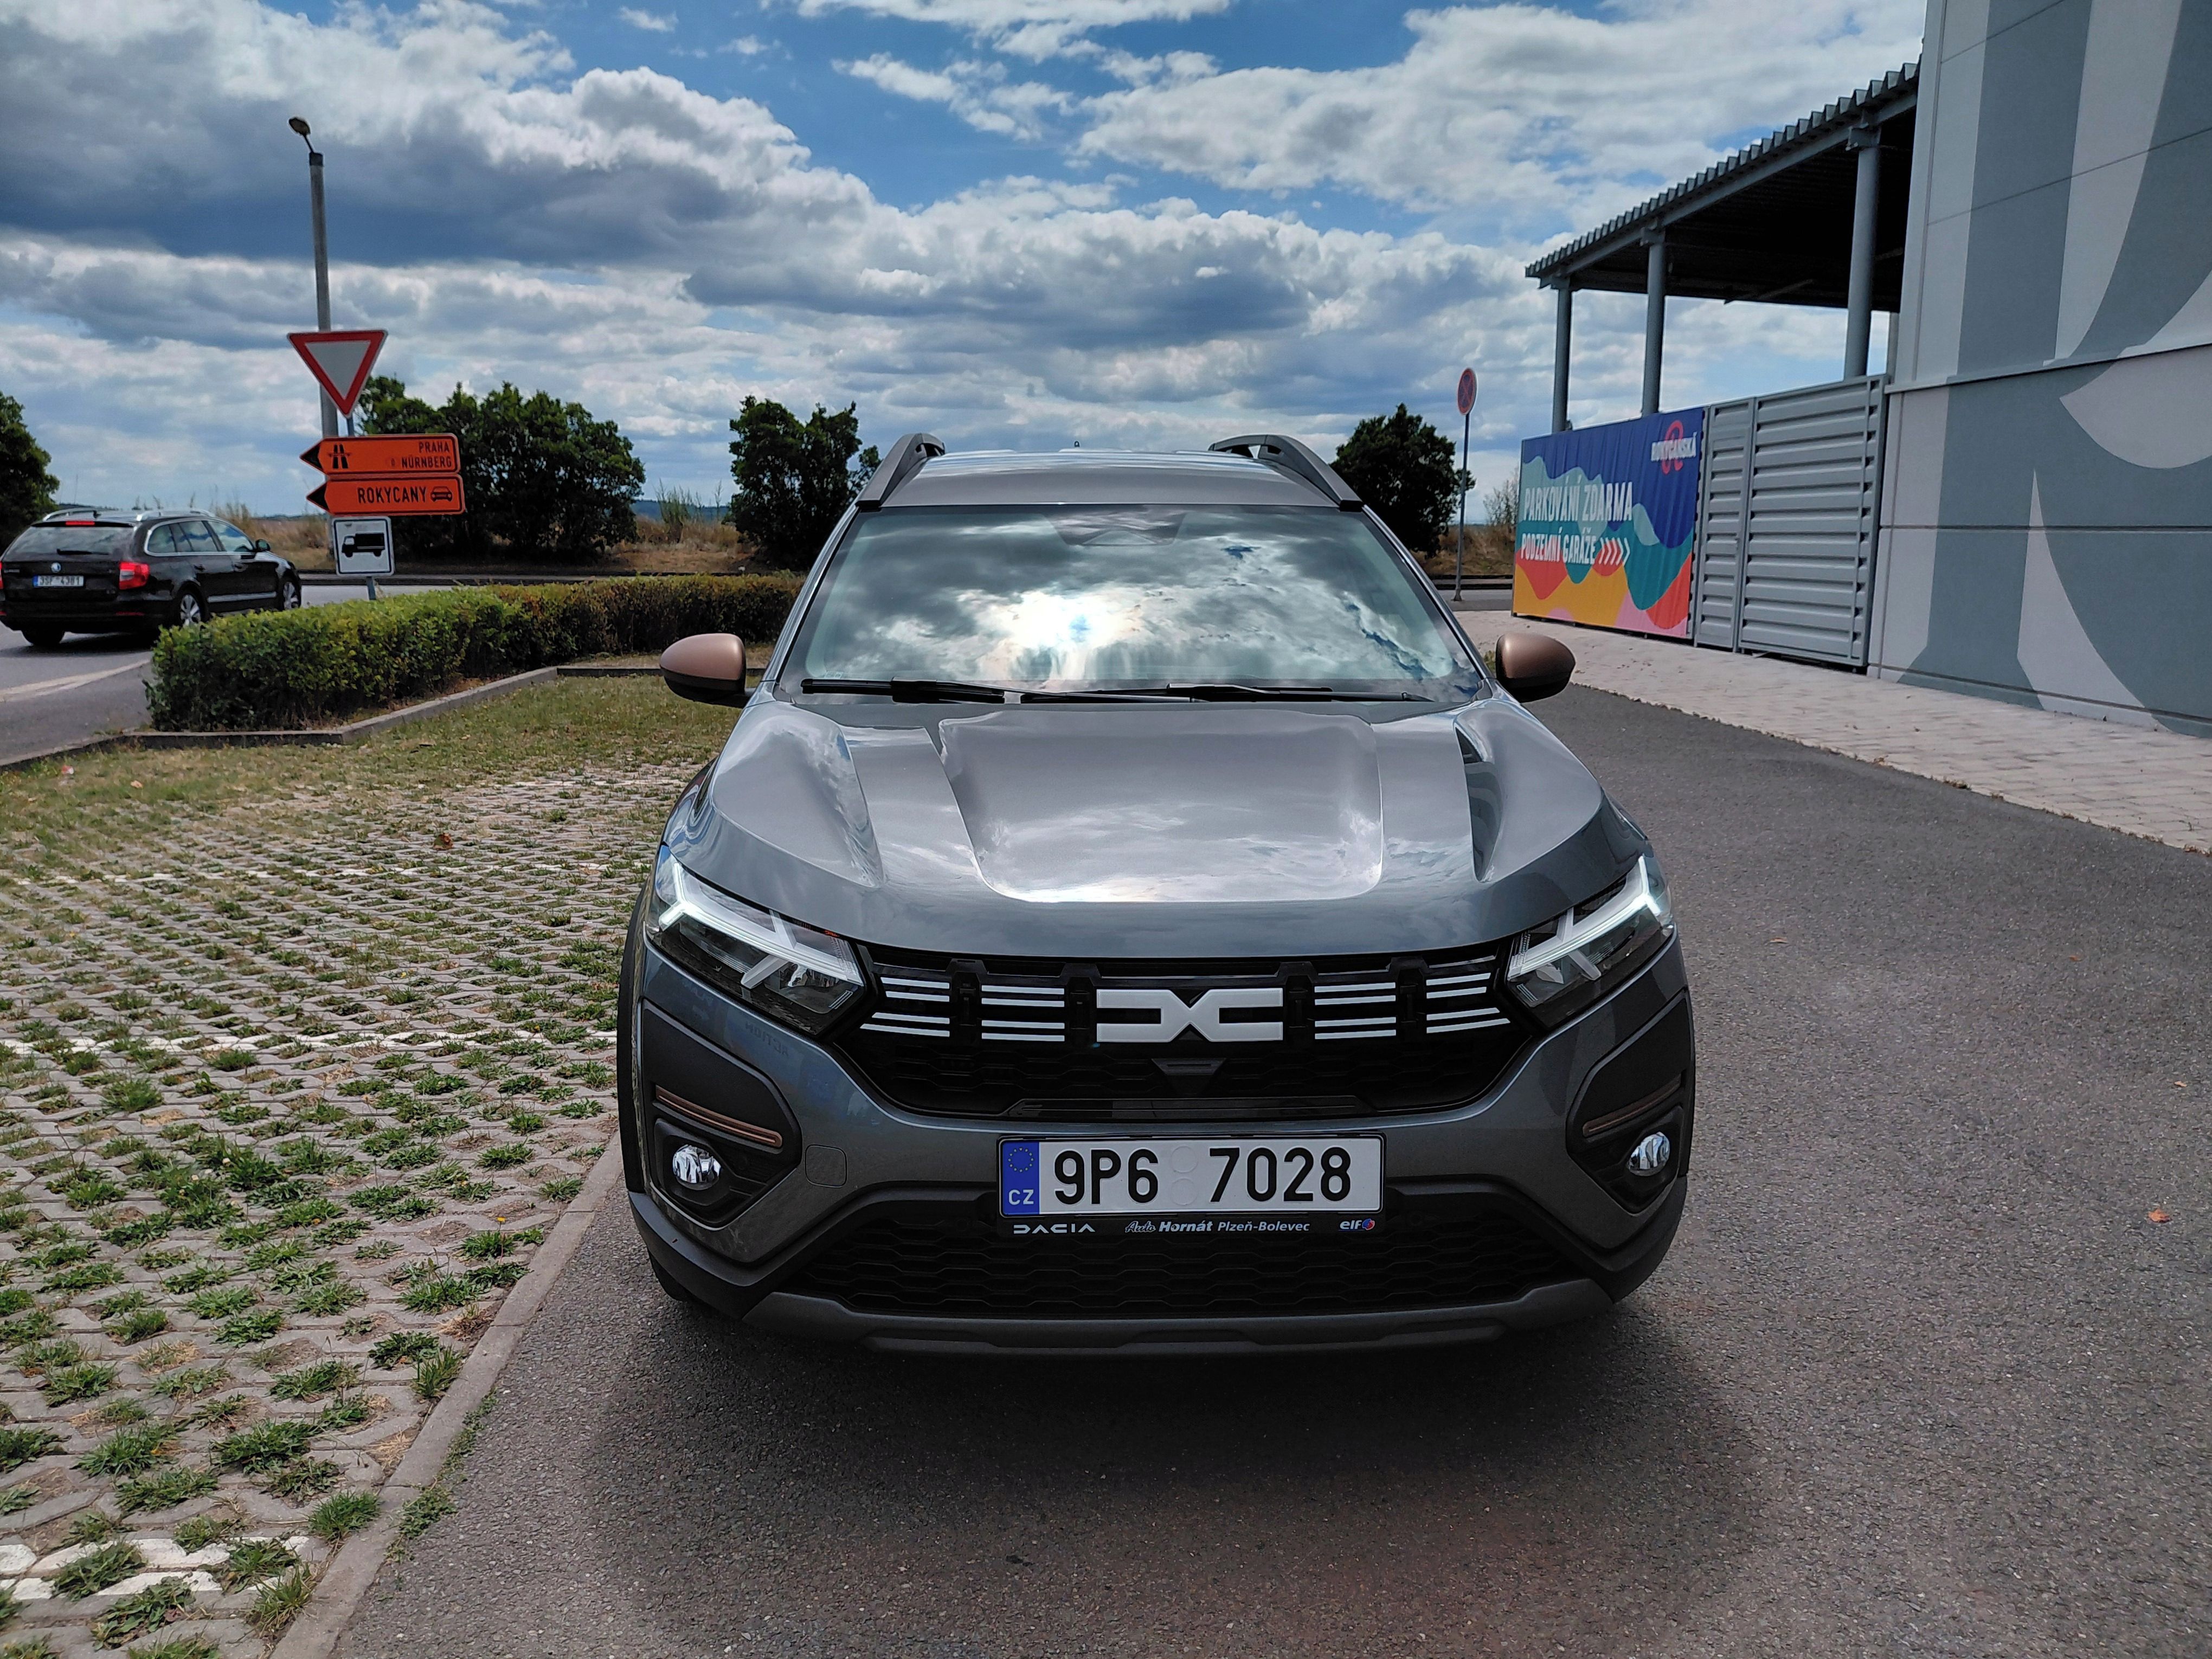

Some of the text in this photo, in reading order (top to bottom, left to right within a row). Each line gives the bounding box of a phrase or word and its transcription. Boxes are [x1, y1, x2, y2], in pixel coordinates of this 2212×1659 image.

[419, 441, 449, 453] PRAHA
[402, 455, 452, 468] NÜRNBERG
[358, 486, 426, 504] ROKYCANY
[1523, 475, 1632, 521] PARKOVÁNÍ ZDARMA
[1521, 526, 1597, 565] PODZEMNÍ GARÁŽE
[1008, 1146, 1352, 1206] CZ 9P6 7028
[1013, 1223, 1096, 1234] DACIA
[1124, 1220, 1310, 1233] Auto Hornát Plzeň-Bolevec
[1339, 1219, 1363, 1230] elf
